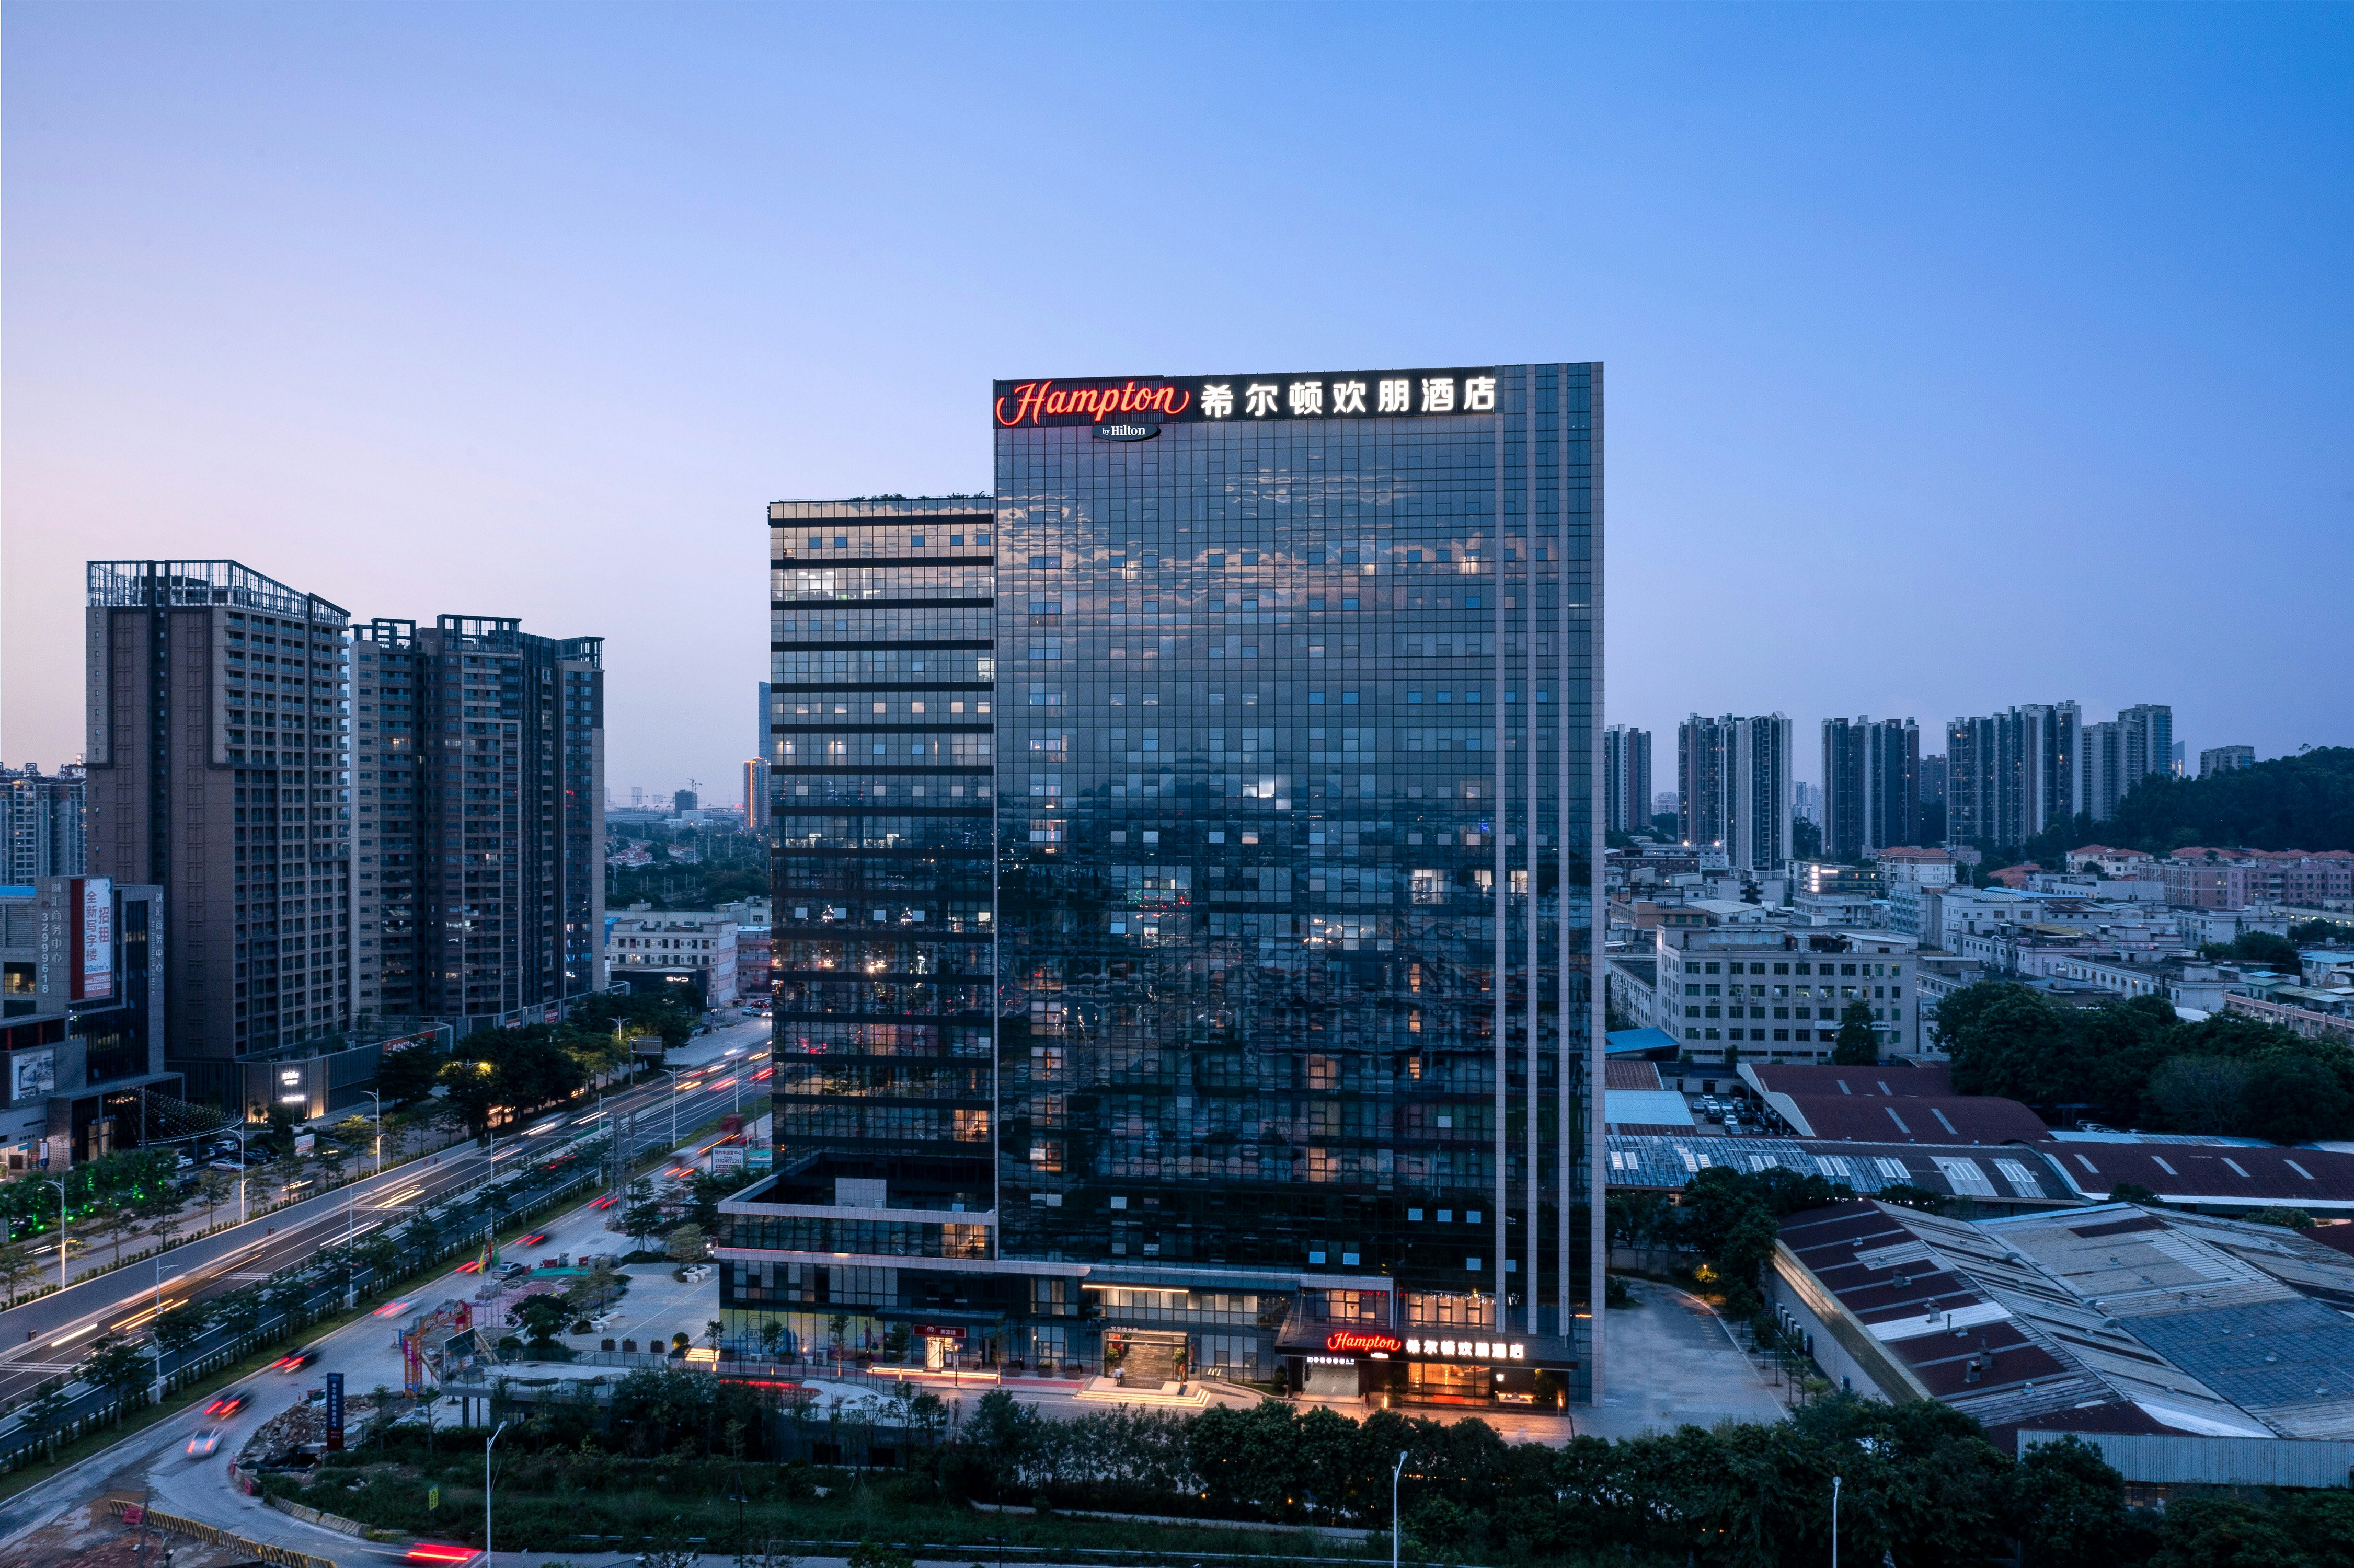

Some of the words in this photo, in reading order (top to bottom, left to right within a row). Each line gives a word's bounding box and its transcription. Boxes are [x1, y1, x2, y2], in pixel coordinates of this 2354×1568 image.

[996, 380, 1190, 426] Hampton
[1201, 376, 1496, 418] 希尔顿欢朋酒店
[1111, 424, 1146, 436] Hilton
[52, 882, 62, 963] 融汇商务中心
[86, 891, 97, 962] 全新写字楼
[99, 906, 110, 943] 招租
[1328, 1332, 1401, 1351] Hampton
